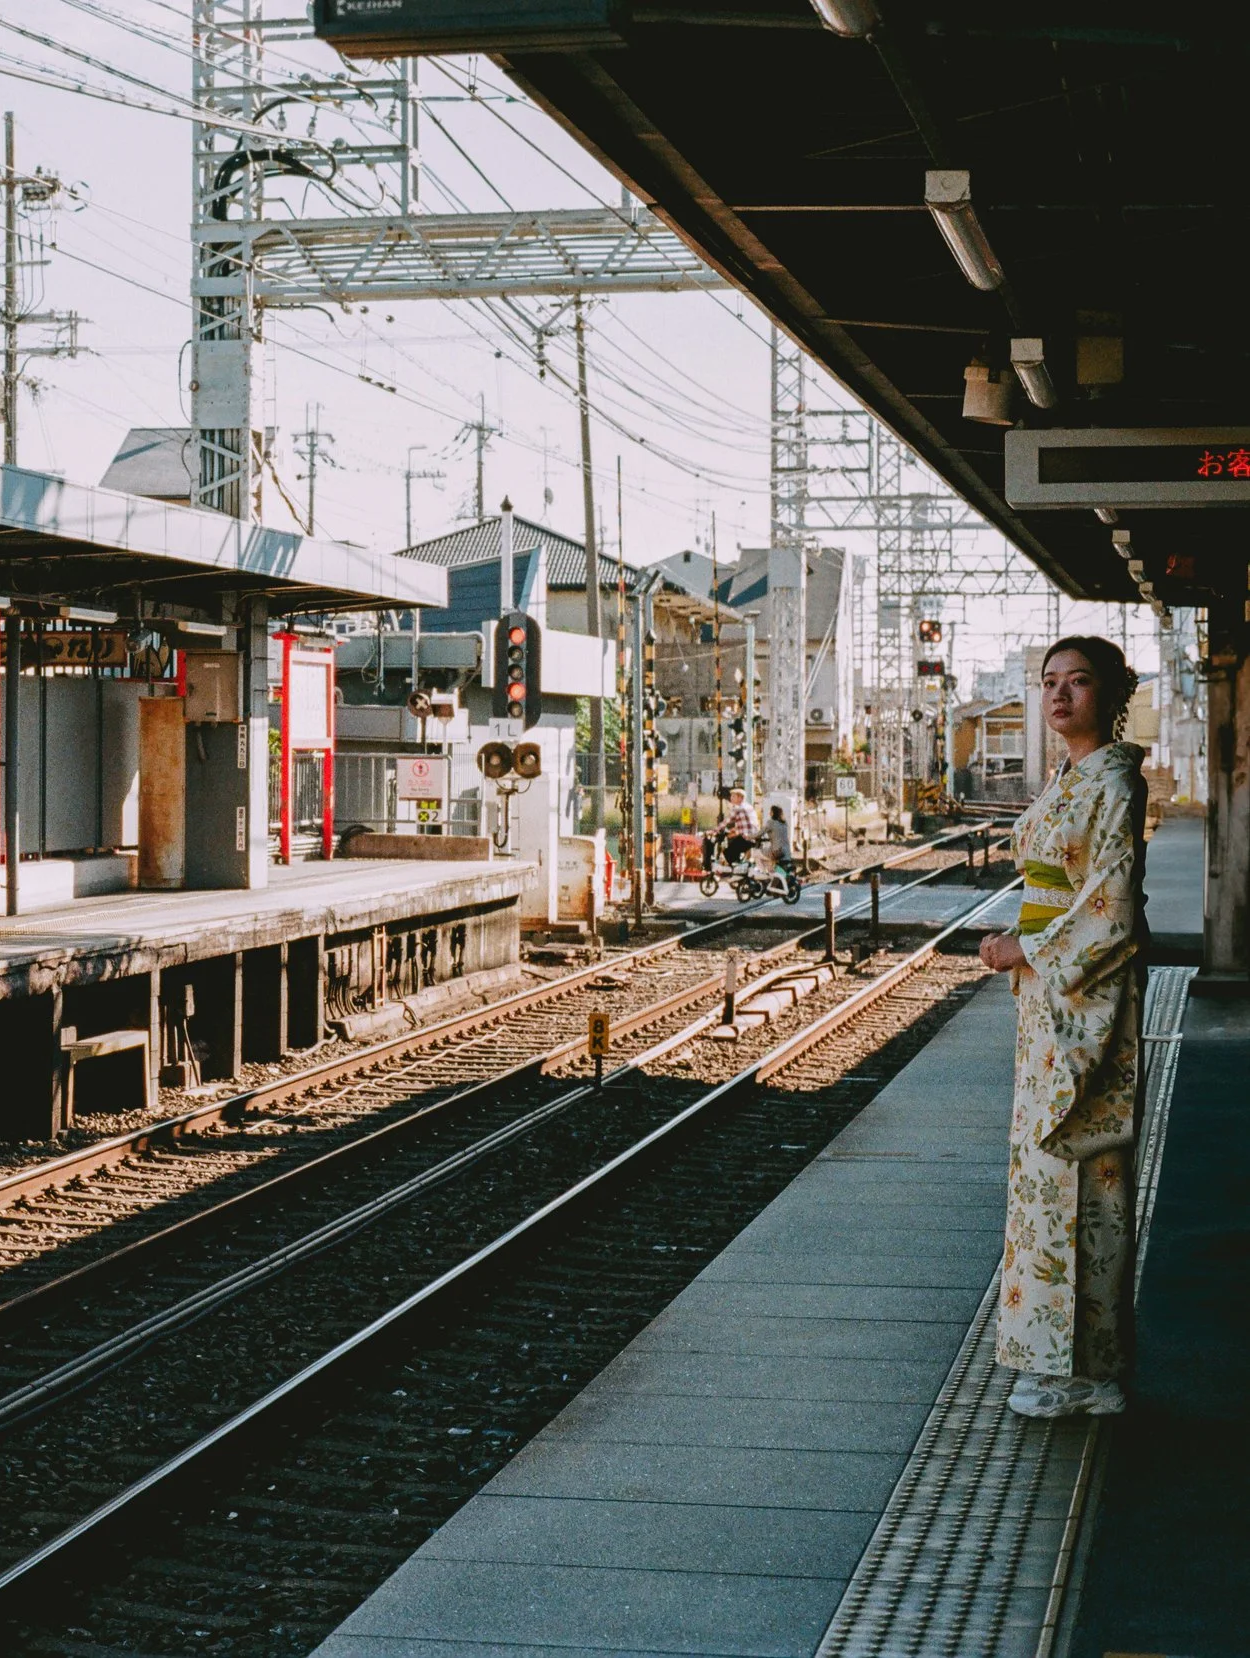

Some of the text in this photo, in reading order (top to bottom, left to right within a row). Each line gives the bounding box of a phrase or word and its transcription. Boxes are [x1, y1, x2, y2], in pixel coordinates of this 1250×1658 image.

[1198, 449, 1250, 478] お客
[839, 779, 854, 790] 60
[431, 811, 439, 822] 2
